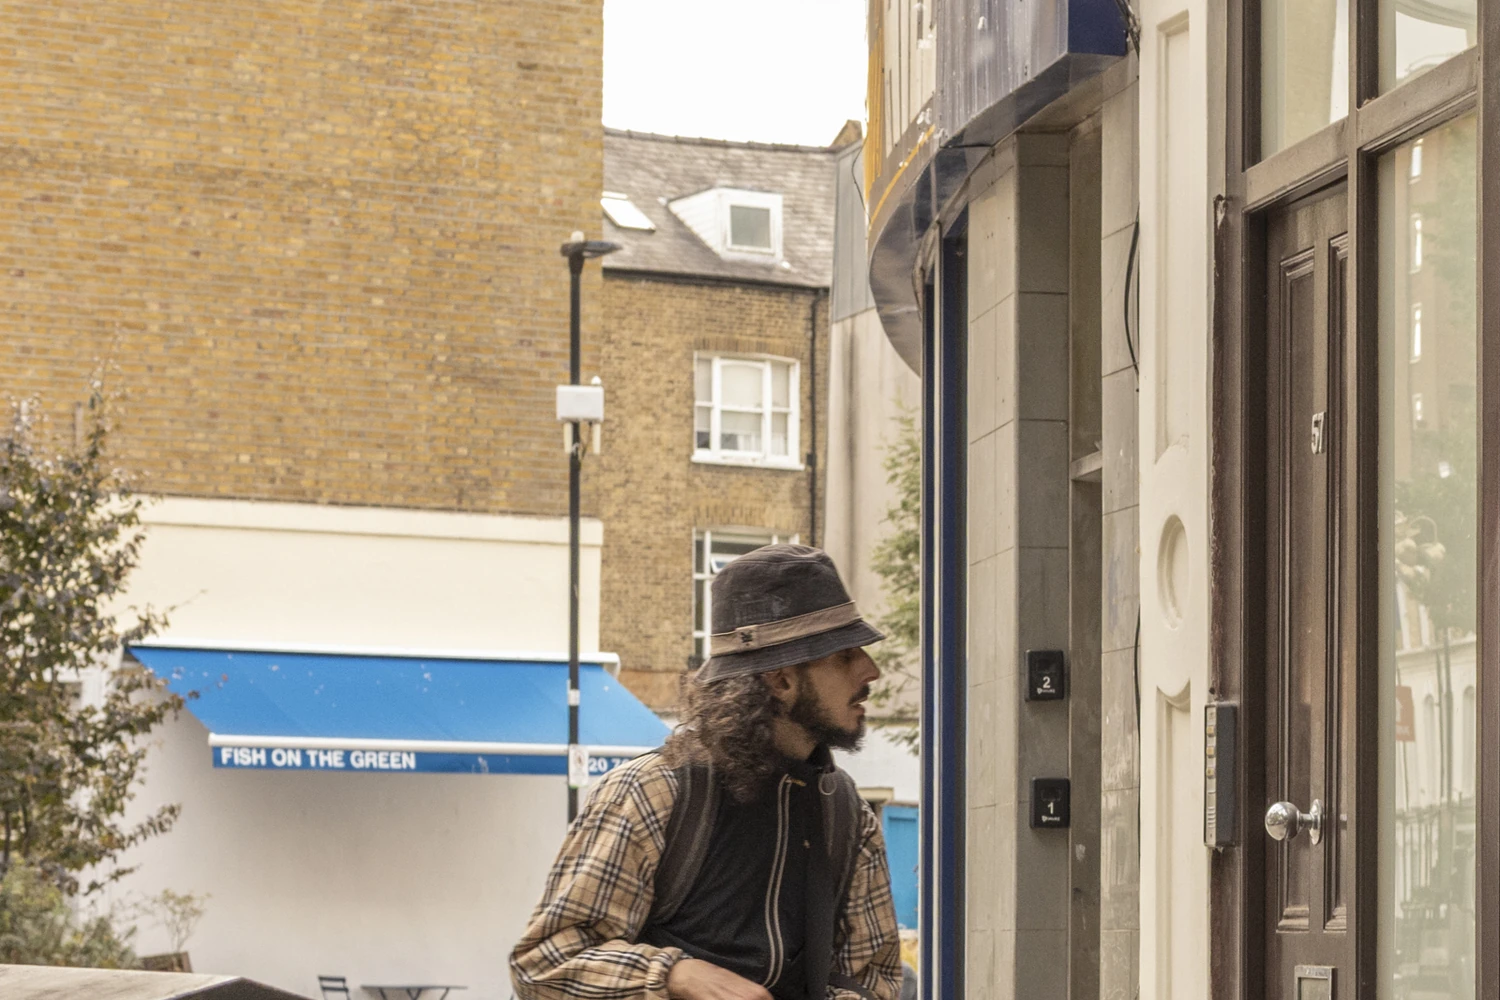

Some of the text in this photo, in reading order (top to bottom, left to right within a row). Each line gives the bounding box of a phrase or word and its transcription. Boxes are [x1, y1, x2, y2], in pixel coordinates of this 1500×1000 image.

[1311, 411, 1324, 454] 57
[1042, 676, 1051, 689] 2
[221, 747, 267, 766] FISH
[271, 748, 302, 767] ON
[306, 749, 346, 768] THE
[350, 750, 416, 769] GREEN
[1047, 802, 1054, 814] 1
